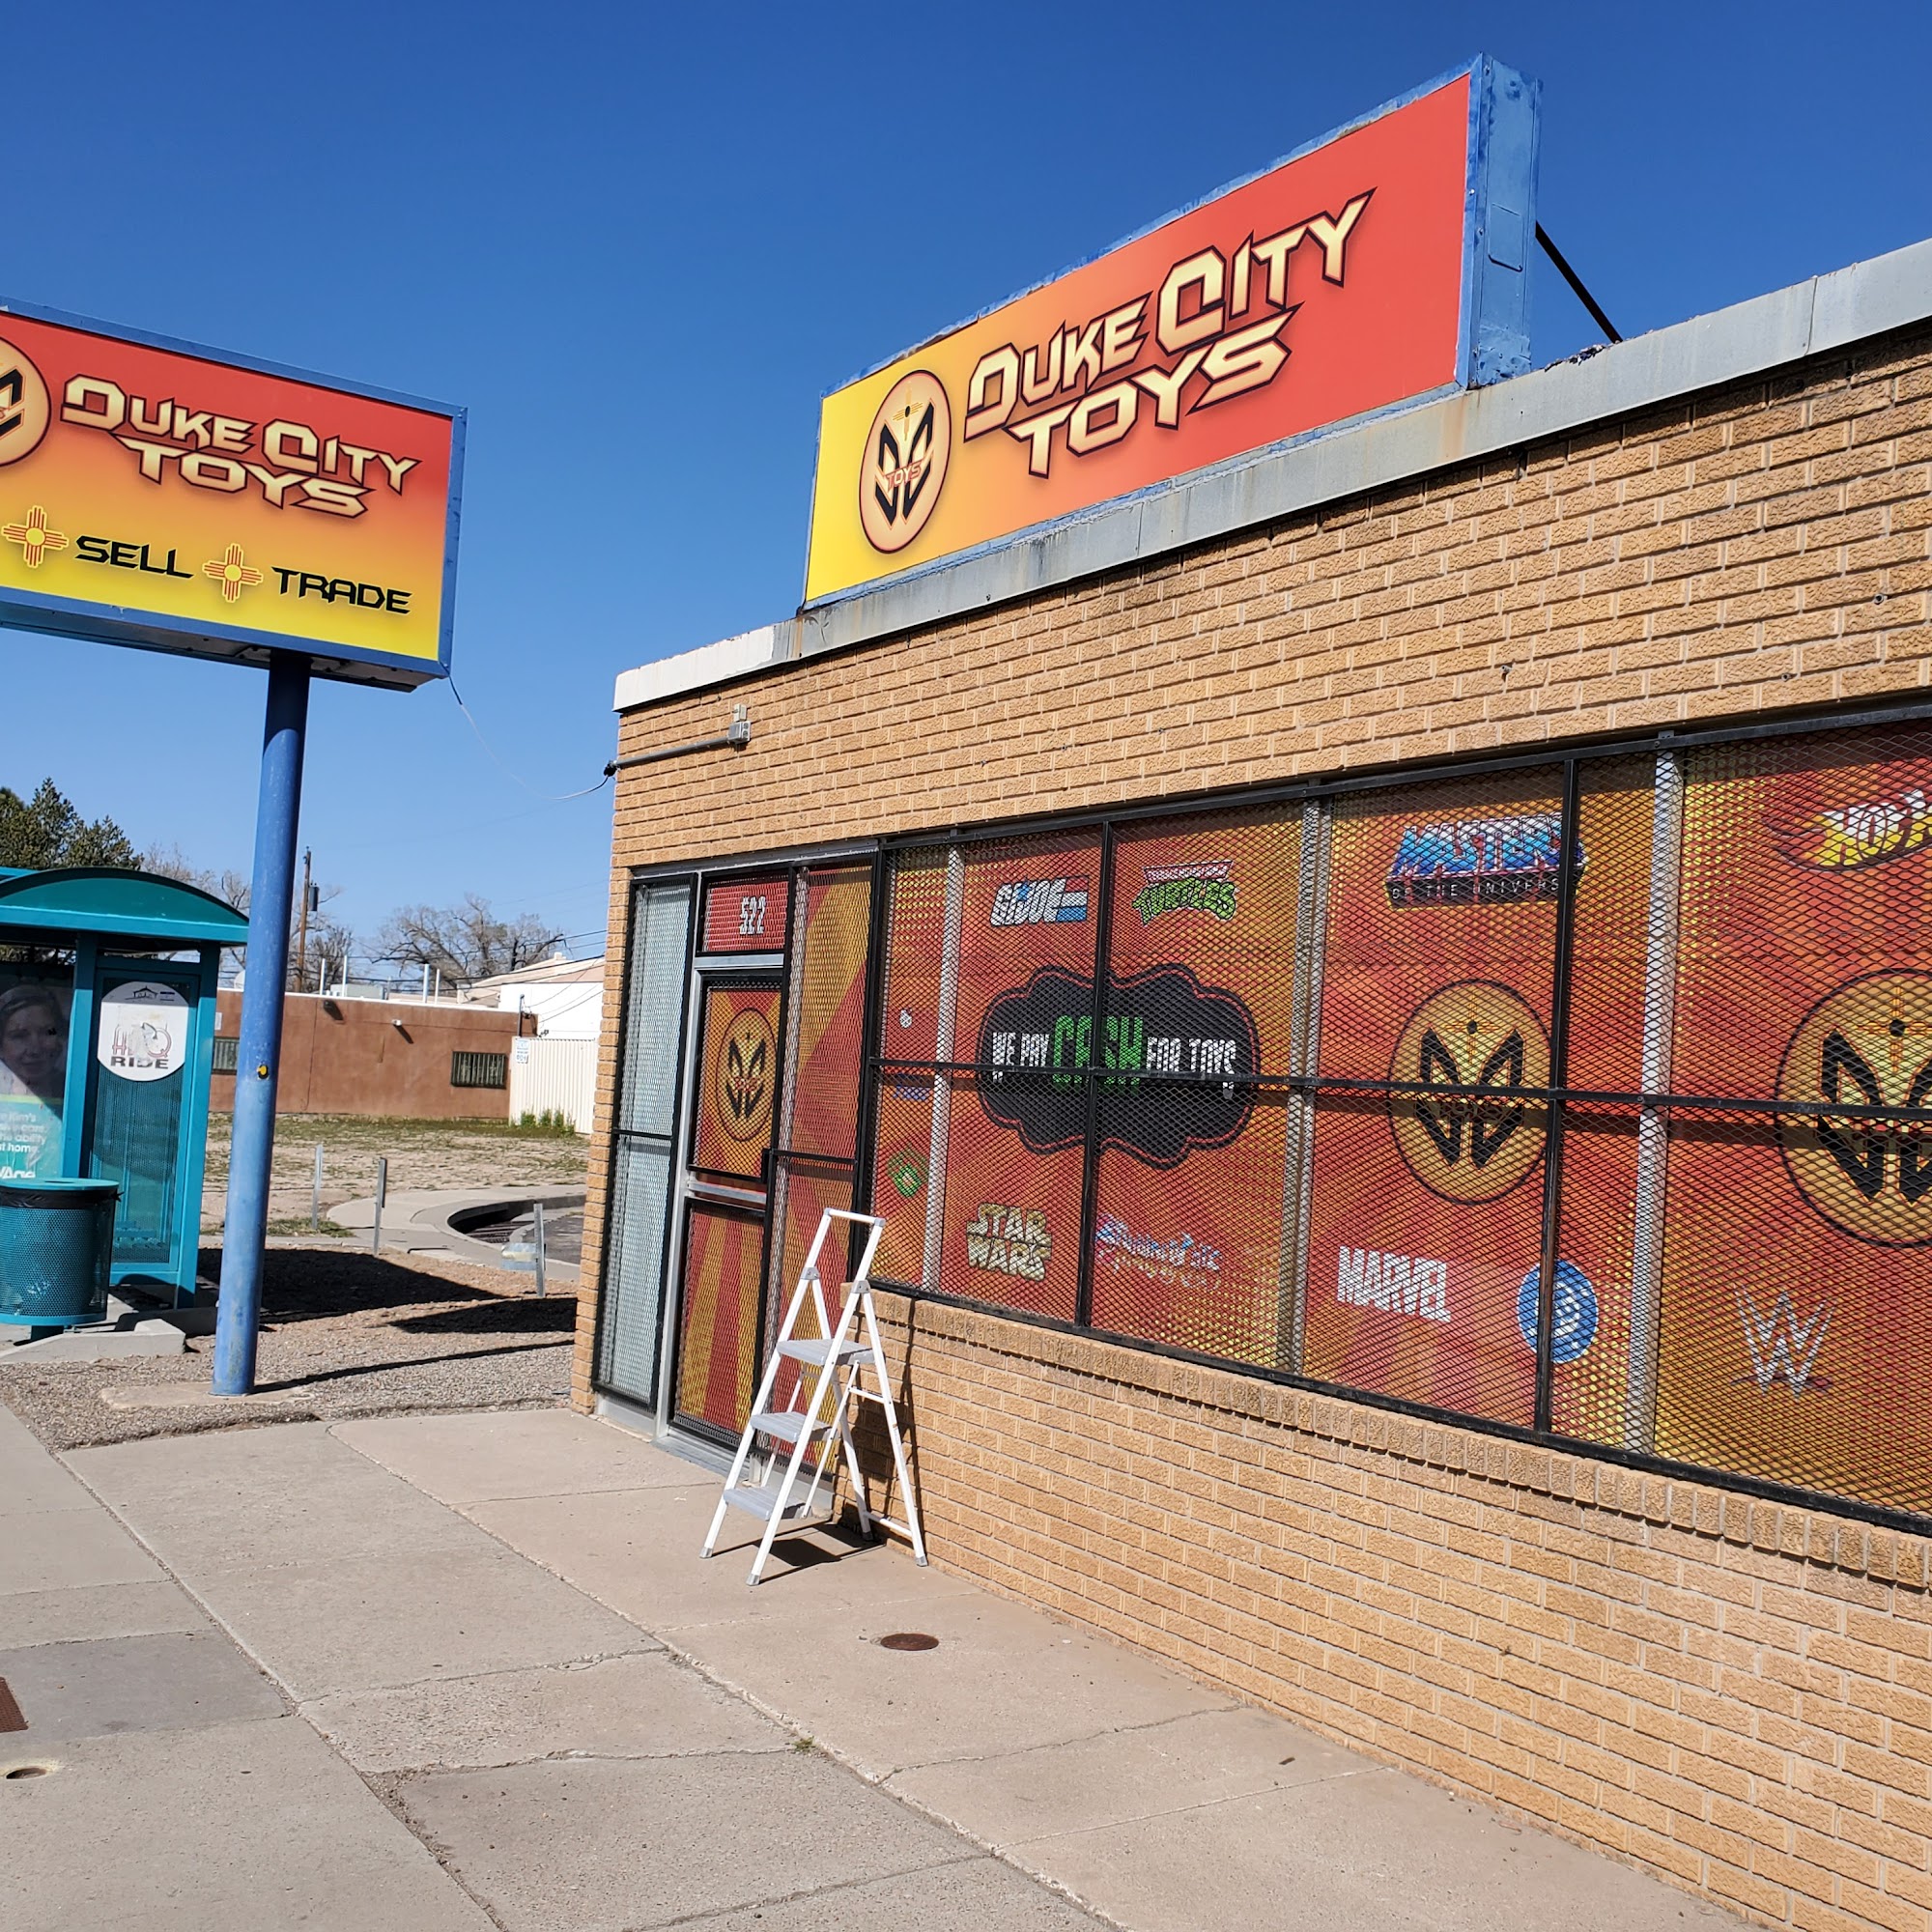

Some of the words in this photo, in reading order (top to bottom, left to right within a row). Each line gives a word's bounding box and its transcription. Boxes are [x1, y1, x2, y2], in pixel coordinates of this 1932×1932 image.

[964, 290, 1153, 440] DUKE
[1155, 186, 1378, 357] CITY
[1001, 300, 1305, 479] TOYS
[60, 374, 259, 454] DUKE
[262, 418, 423, 496] CITY
[110, 431, 376, 519] TOYS
[885, 459, 923, 491] TOYS
[74, 534, 194, 580] SELL
[270, 566, 412, 614] TRADE
[739, 895, 767, 935] 522
[1472, 876, 1561, 895] UNIVERS
[1020, 1033, 1049, 1068] PAY
[1052, 1015, 1143, 1086] CASH
[1146, 1037, 1180, 1074] FOR
[1189, 1038, 1236, 1088] TOYS
[967, 1203, 1051, 1247] STAR
[967, 1236, 1051, 1282] WARS
[1337, 1246, 1451, 1323] MARVEL
